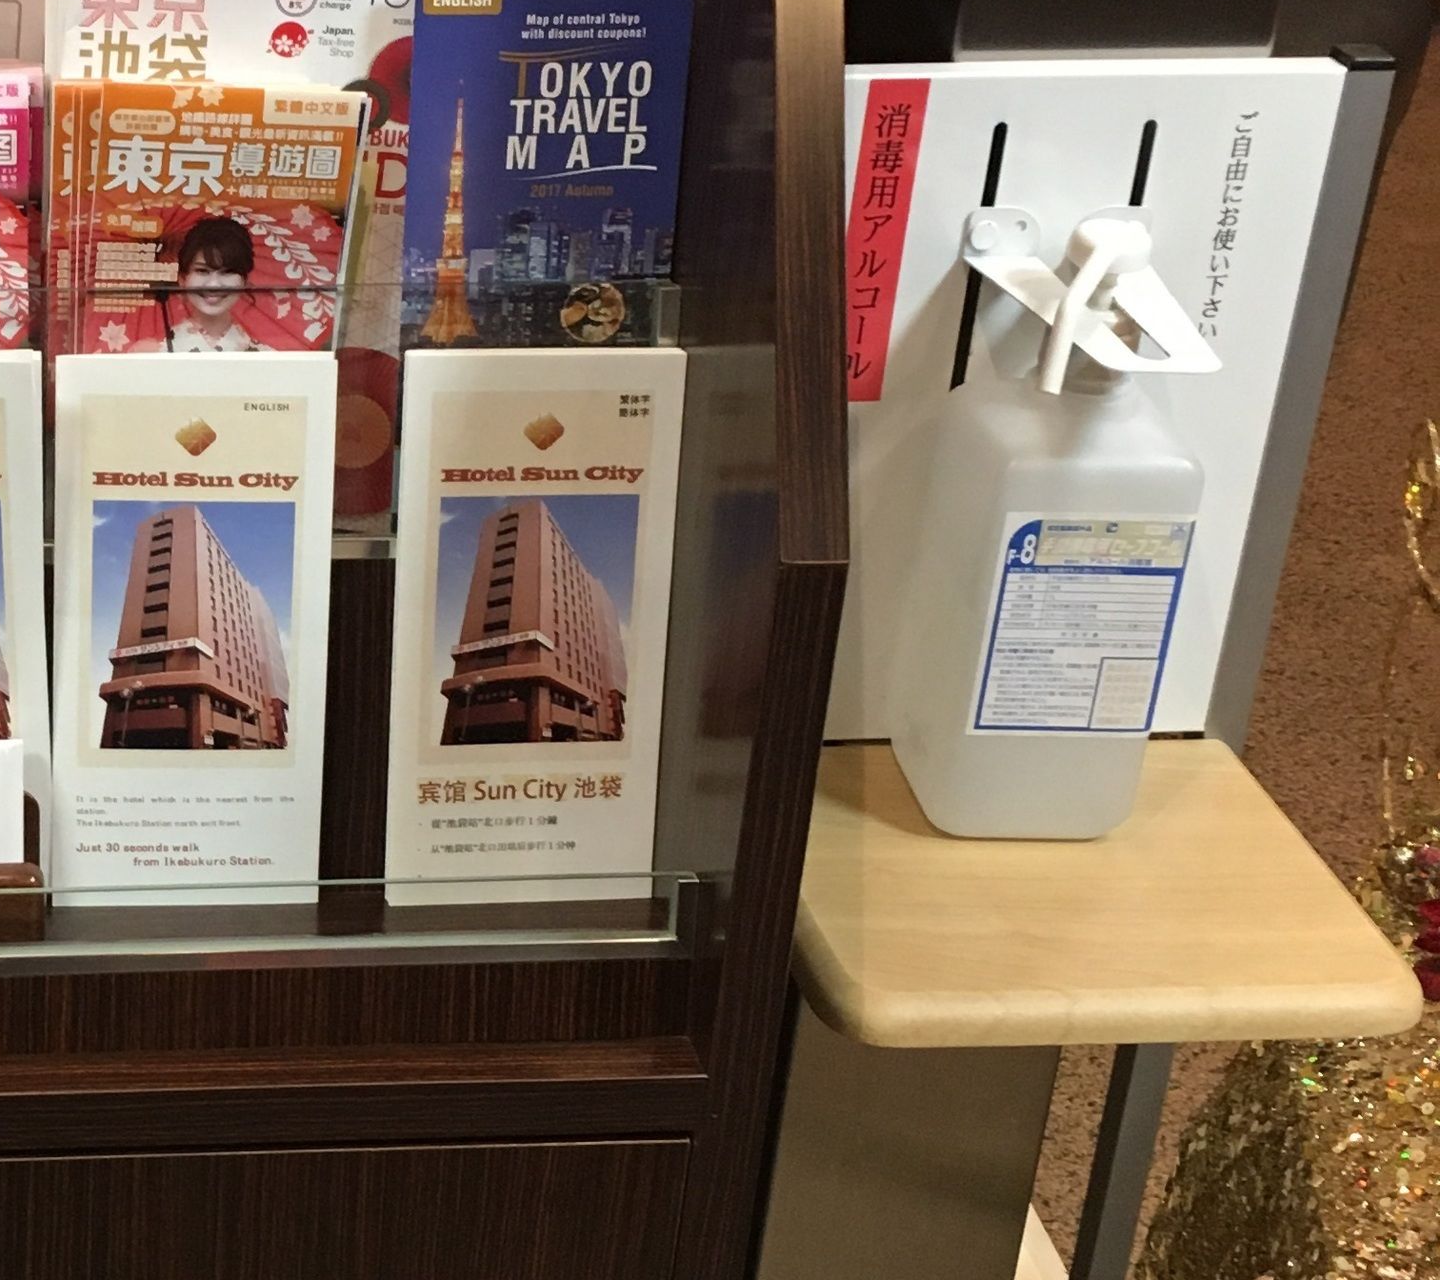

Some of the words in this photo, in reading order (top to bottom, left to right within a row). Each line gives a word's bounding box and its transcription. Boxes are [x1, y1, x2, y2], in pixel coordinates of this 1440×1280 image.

[320, 1, 352, 11] charge
[526, 14, 549, 27] Map
[609, 14, 640, 27] Tokyo
[322, 26, 355, 36] Japan.
[521, 28, 544, 39] with
[548, 28, 594, 39] discount
[79, 31, 209, 82] 池袋
[330, 47, 354, 58] Shop
[499, 50, 653, 98] TOKYO
[510, 98, 648, 134] TRAVEL
[1198, 111, 1260, 337] ご自由にお使い下さい
[844, 103, 912, 381] 消毒用アルコール
[92, 472, 169, 487] Hotel
[174, 472, 234, 488] Sun
[239, 472, 299, 492] City
[441, 467, 515, 483] Hotel
[520, 467, 580, 482] Sun
[584, 465, 645, 484] City
[418, 781, 466, 804] 宾馆
[474, 780, 517, 801] Sun
[523, 778, 567, 802] City
[573, 775, 622, 799] 池袋
[76, 843, 102, 853] Just
[229, 856, 274, 866] Station.
